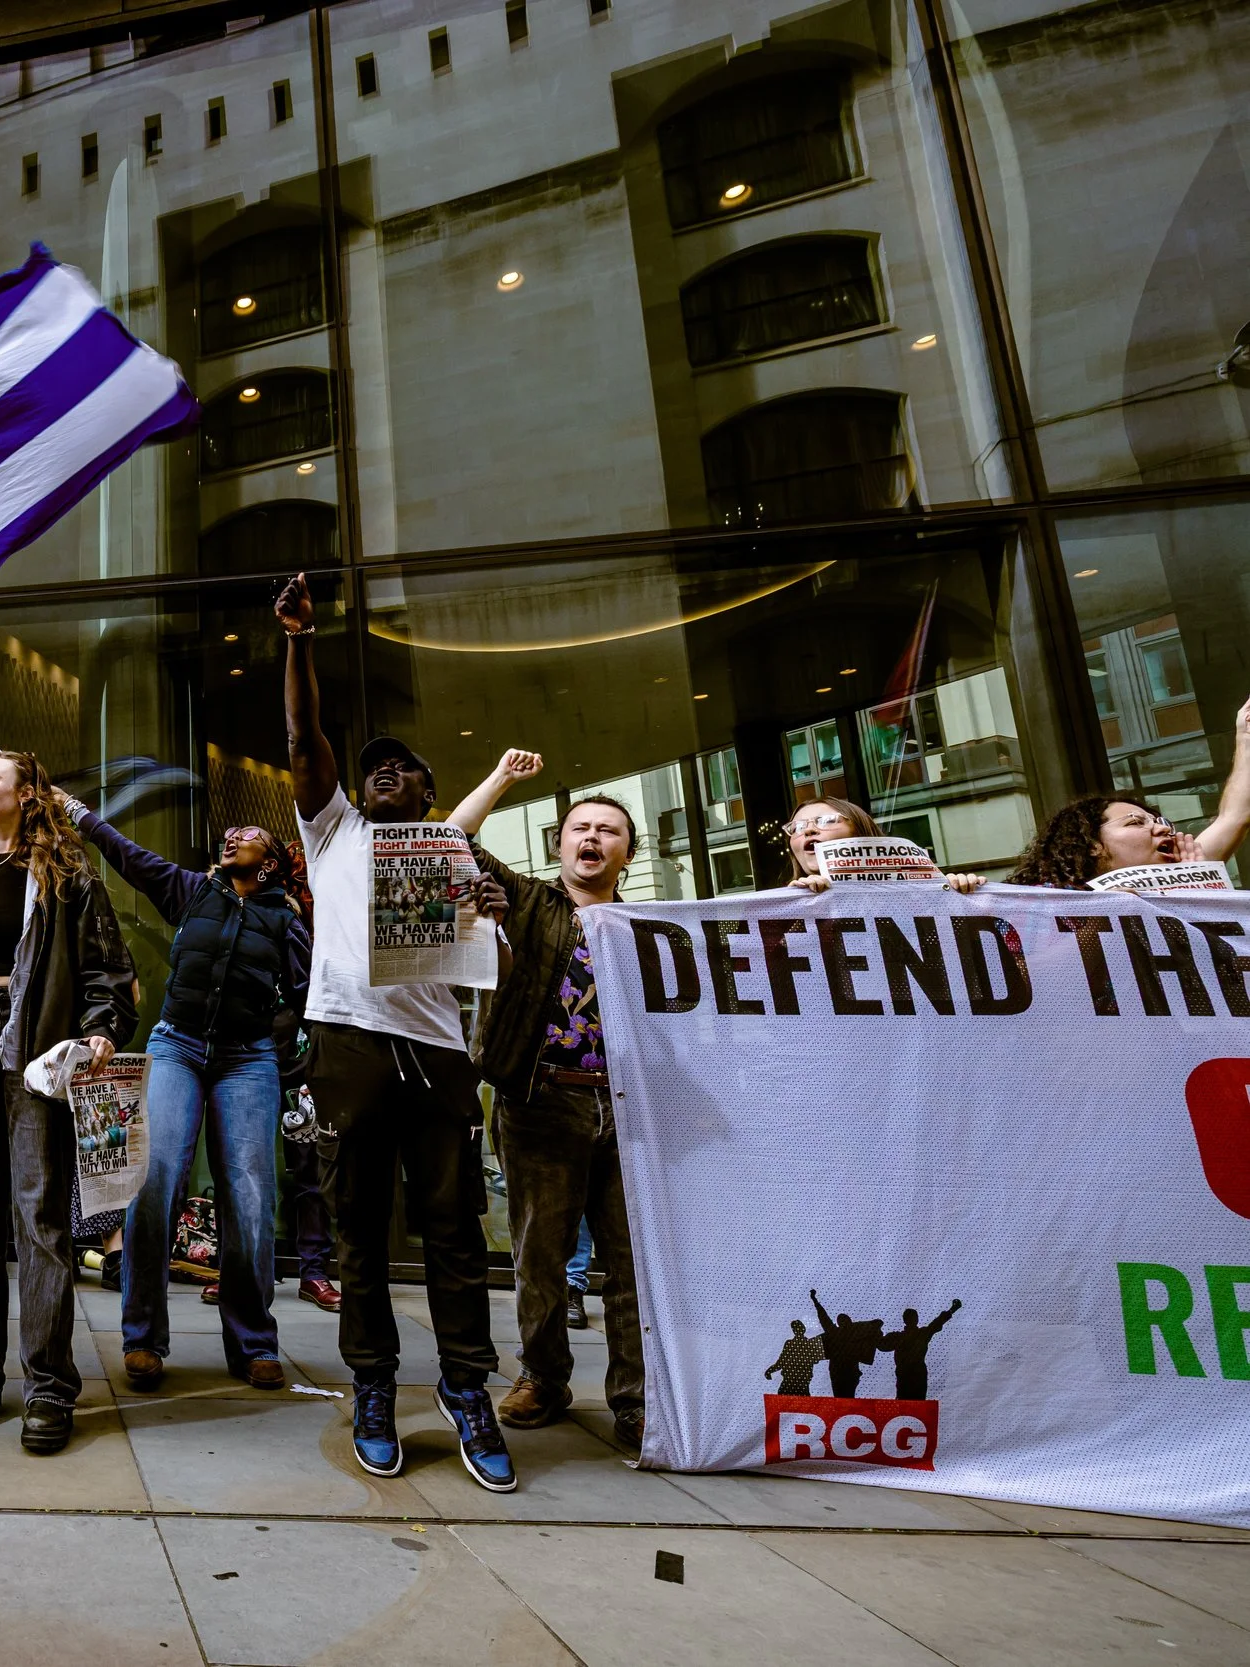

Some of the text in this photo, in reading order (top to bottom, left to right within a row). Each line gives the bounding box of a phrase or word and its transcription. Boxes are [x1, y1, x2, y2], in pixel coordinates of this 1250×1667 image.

[373, 828, 419, 839] FIGHT
[373, 840, 469, 850] FIGHT IMPERIALIS
[823, 847, 873, 859] FIGHT
[374, 858, 395, 867] WE
[400, 857, 436, 867] HAVE
[440, 857, 449, 866] A
[826, 859, 862, 868] FIGHT
[374, 868, 400, 877] DUTY
[403, 868, 416, 876] TO
[420, 867, 450, 876] FIGHT
[857, 873, 892, 881] HAVE
[896, 873, 905, 881] A
[1155, 870, 1222, 886] RACISM!
[375, 923, 454, 935] WE HAVE A
[375, 934, 454, 945] DUTY TO WIN
[629, 916, 1033, 1016] DEFEND
[108, 1057, 146, 1067] CISM!
[86, 1084, 108, 1095] HAVE
[110, 1082, 116, 1092] A
[88, 1095, 96, 1104] TO
[98, 1092, 117, 1102] FIGHT
[79, 1147, 127, 1164] WE HAVE A
[80, 1157, 127, 1174] DUTY TO WIN
[779, 1412, 927, 1459] RCG
